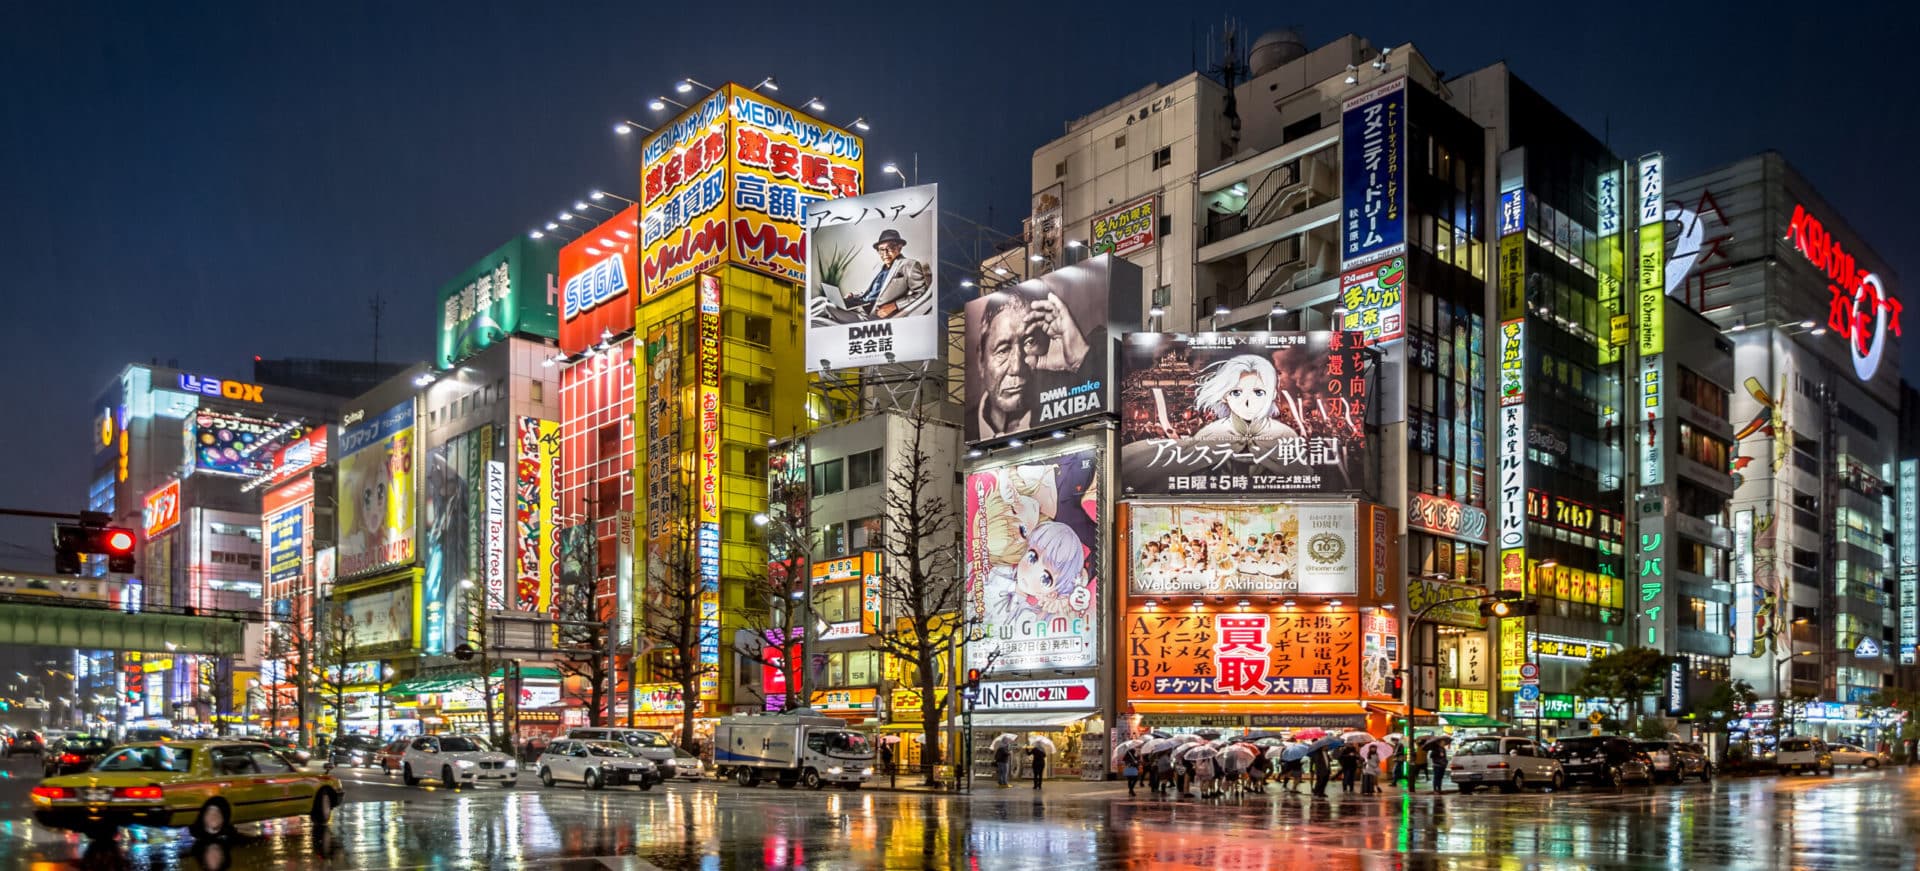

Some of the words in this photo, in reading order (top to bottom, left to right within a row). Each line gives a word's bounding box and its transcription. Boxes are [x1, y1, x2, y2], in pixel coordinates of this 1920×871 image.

[735, 97, 860, 160] MEDIAリサイクル
[645, 124, 726, 203] 激安販売
[736, 129, 859, 198] 激安販売
[1363, 103, 1383, 248] アメニティードリーム
[644, 168, 724, 248] 高額買取
[643, 220, 727, 294] Mulan
[749, 256, 787, 275] ムーラン
[1644, 252, 1655, 285] Yellow
[565, 253, 628, 320] SEGA
[1344, 285, 1400, 310] まんが
[849, 323, 893, 340] DMM
[849, 339, 893, 356] 英会話
[1269, 335, 1307, 345] 田中芳樹
[1644, 294, 1655, 350] Submarine
[1039, 391, 1101, 422] AKIBA
[703, 391, 718, 519] お売り下さい。
[1145, 436, 1340, 471] アルスラーン戦記
[1252, 475, 1322, 485] TVアニメ放送中
[1503, 407, 1521, 528] 喫茶室ルノアール
[490, 466, 503, 505] AKKY
[490, 518, 503, 576] Tax-free
[622, 515, 631, 544] GAME
[1138, 577, 1201, 591] Welcome
[1206, 578, 1219, 591] to
[1226, 577, 1299, 591] Akihabara
[1642, 533, 1663, 644] リバティー
[1129, 616, 1152, 692] AKBもの
[1155, 616, 1172, 673] アイドル
[1174, 616, 1192, 658] アニメ
[1193, 615, 1212, 676] 美少女系
[1217, 617, 1267, 693] 買取
[1274, 616, 1293, 676] フィギュア
[1294, 616, 1312, 659] ホビー
[1313, 615, 1332, 676] 携帯電話
[1334, 616, 1353, 695] アップルとか
[1003, 689, 1047, 701] COMIC
[1048, 687, 1068, 701] ZIN
[1156, 678, 1212, 693] チケット
[1273, 678, 1329, 694] 大黒屋
[1523, 667, 1535, 676] 40
[1544, 699, 1574, 712] リバティー
